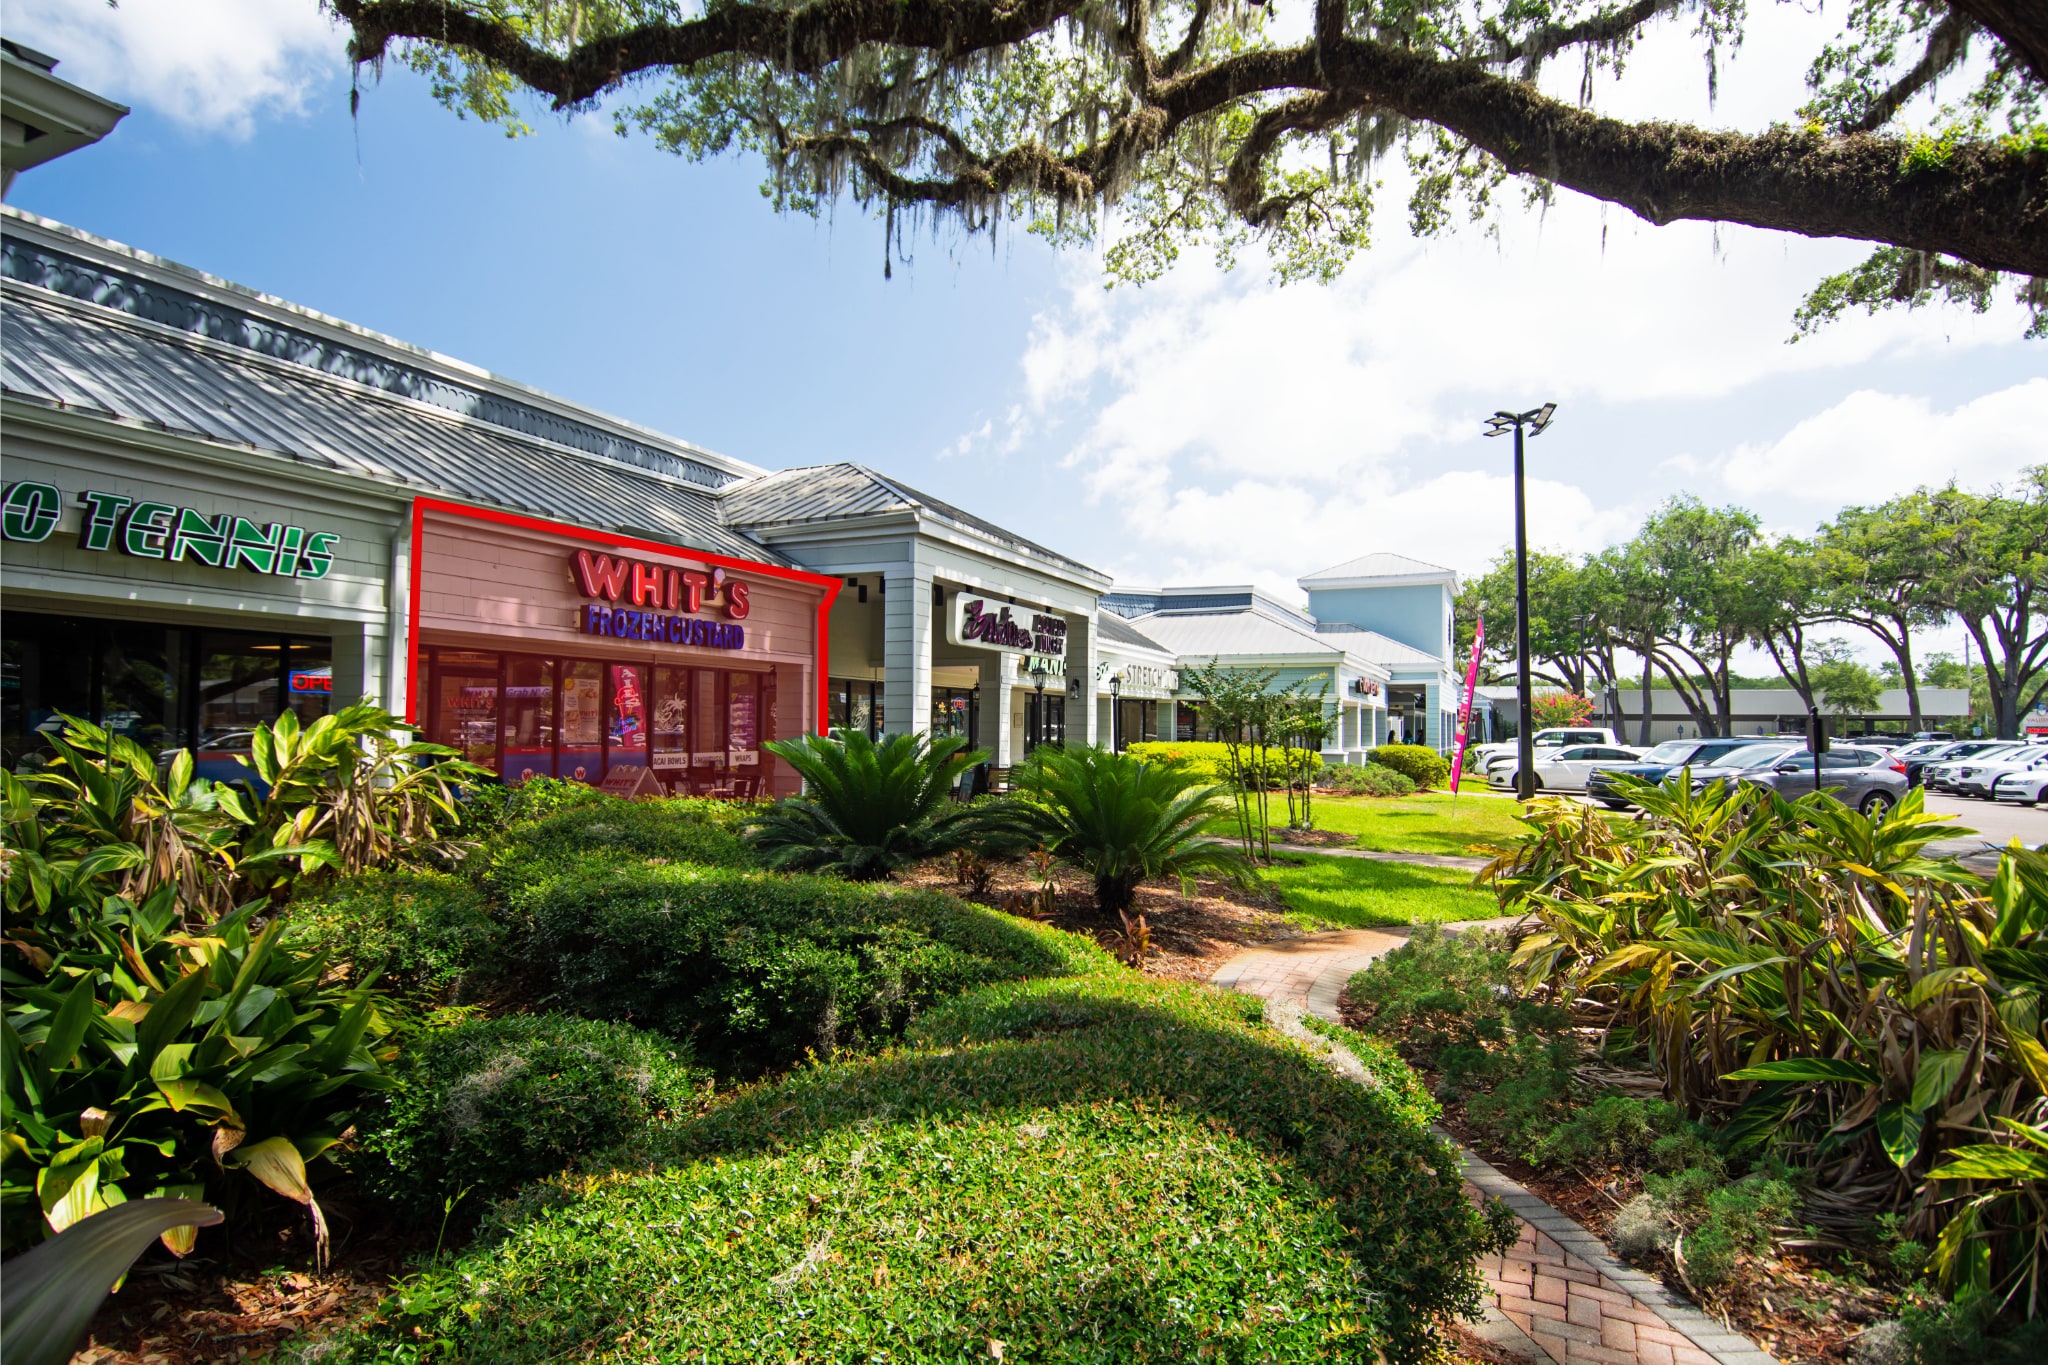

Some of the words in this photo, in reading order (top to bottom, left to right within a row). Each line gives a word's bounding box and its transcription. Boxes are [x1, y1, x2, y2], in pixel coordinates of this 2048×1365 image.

[1, 480, 62, 543] O
[79, 489, 341, 581] TENNIS
[571, 549, 750, 620] WHIT'S
[582, 603, 666, 642] FROZEN
[668, 614, 745, 650] CUSTARD
[667, 756, 686, 765] BOWLS
[734, 754, 752, 763] WRAPS
